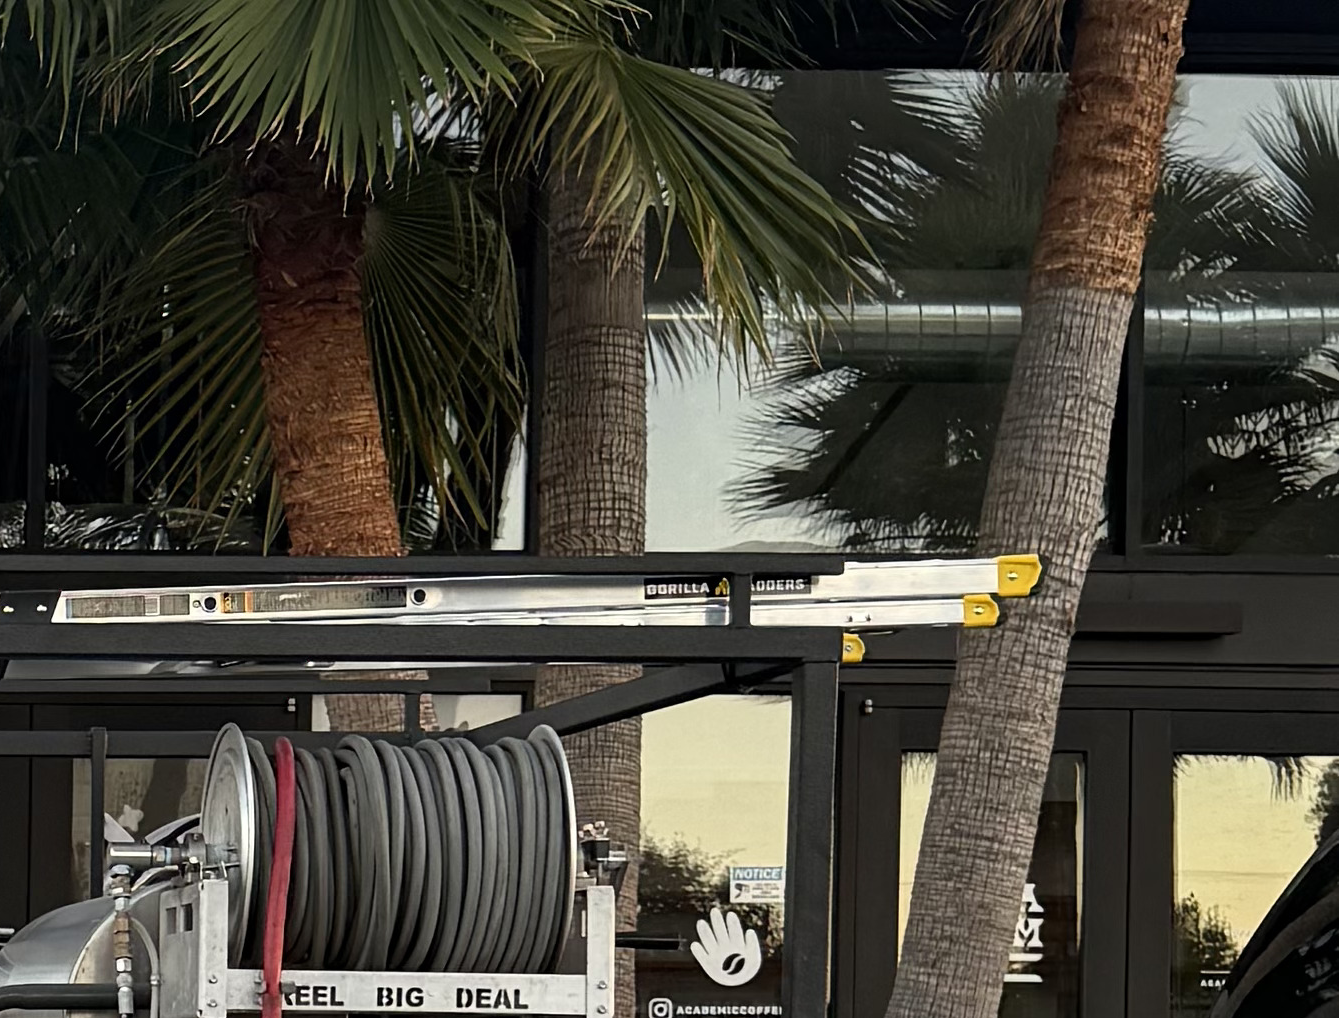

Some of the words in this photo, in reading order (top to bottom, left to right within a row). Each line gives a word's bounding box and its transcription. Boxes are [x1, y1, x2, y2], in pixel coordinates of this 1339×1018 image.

[646, 582, 710, 596] GORILLA
[751, 578, 805, 592] DDERS
[734, 868, 781, 879] NOTICE
[376, 986, 425, 1008] BIG
[455, 987, 530, 1010] DEAL
